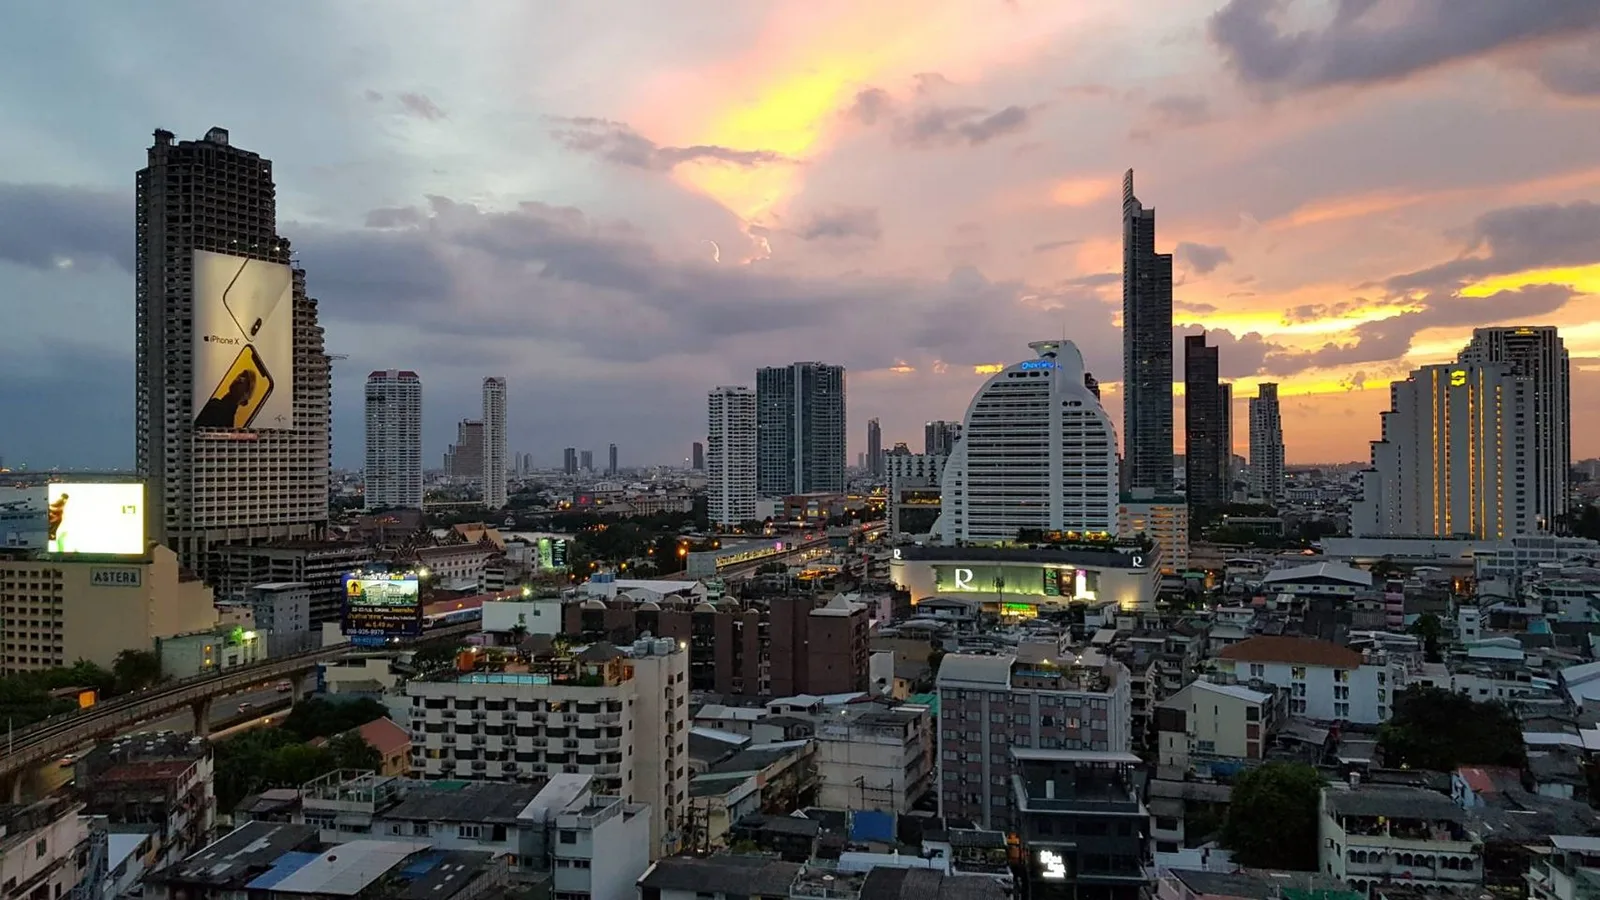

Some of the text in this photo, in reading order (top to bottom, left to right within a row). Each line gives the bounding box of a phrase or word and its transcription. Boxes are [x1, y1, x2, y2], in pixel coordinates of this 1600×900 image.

[210, 335, 240, 346] iPhone X
[893, 548, 902, 560] R
[1132, 556, 1144, 567] R
[955, 569, 978, 590] R
